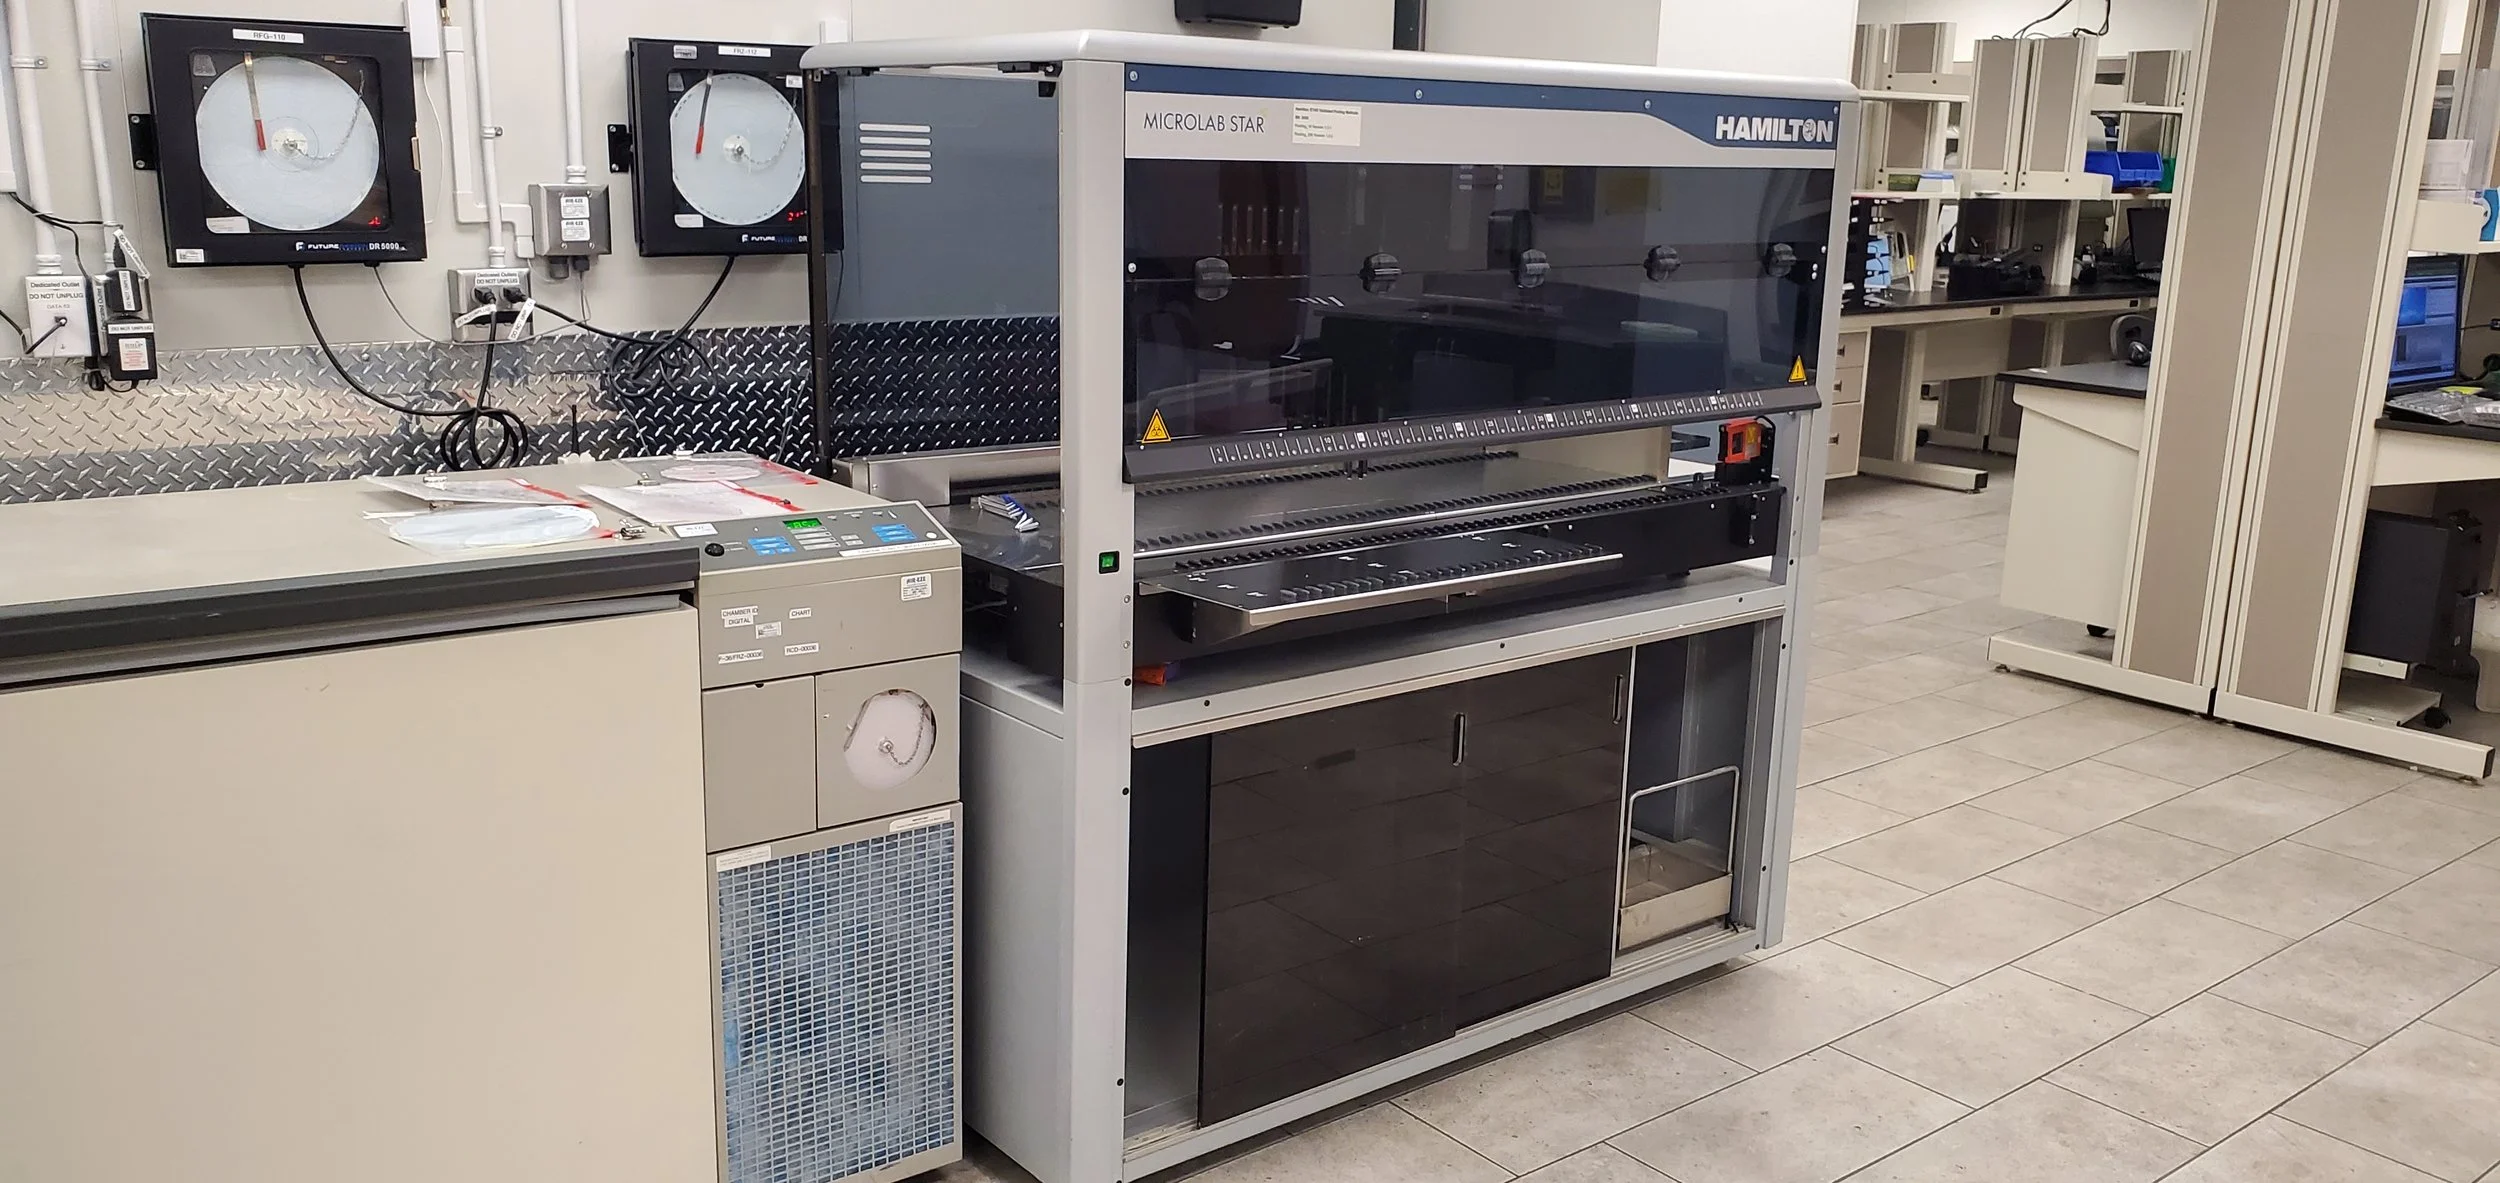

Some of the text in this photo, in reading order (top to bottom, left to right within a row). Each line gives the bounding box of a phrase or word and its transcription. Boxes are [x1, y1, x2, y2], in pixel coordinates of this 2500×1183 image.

[252, 31, 286, 41] RFG-110
[1143, 112, 1264, 133] MICROLAB STAR
[1715, 115, 1834, 142] HAMILTON
[722, 608, 750, 617] CHAMBER
